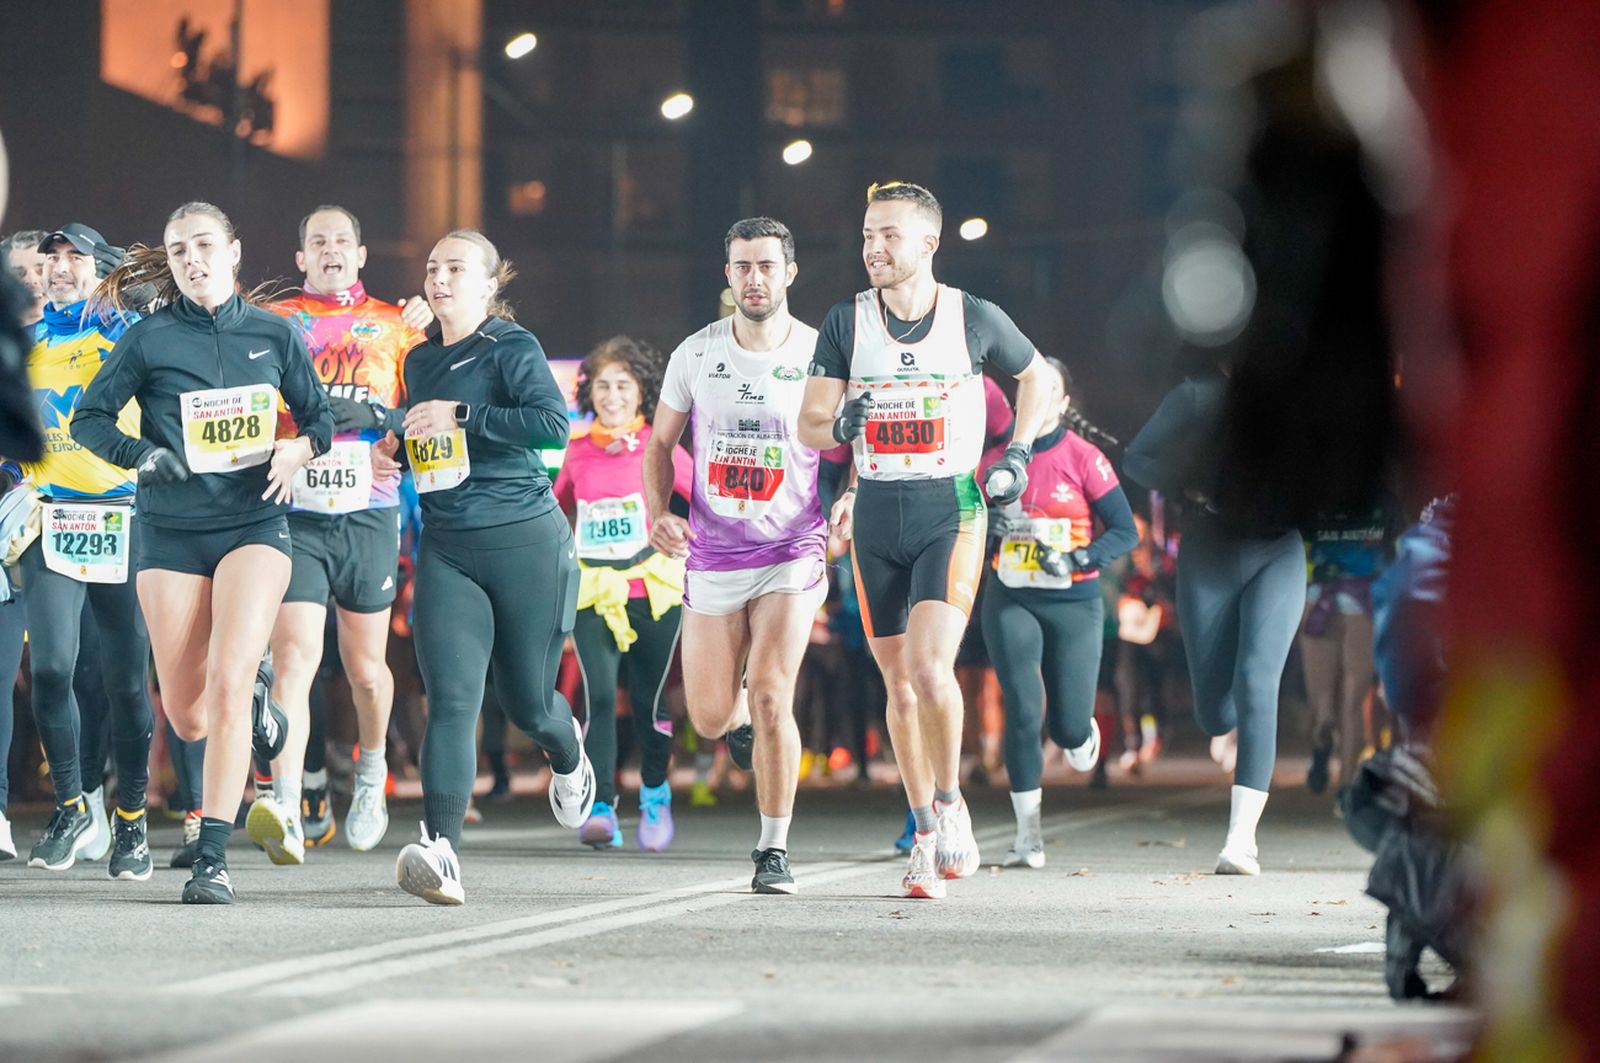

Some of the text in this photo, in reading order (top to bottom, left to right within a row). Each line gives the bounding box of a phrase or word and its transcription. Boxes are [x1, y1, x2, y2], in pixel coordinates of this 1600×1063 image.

[309, 345, 364, 384] OY
[203, 397, 241, 408] NOCHE DE
[876, 400, 915, 410] NOCHE DE
[193, 410, 212, 419] SAN
[869, 410, 885, 420] SAN
[202, 415, 260, 444] 4828
[717, 431, 747, 440] UTACIÓN
[876, 420, 934, 445] 4830
[52, 442, 83, 453] EJIDO
[412, 434, 453, 464] 4829
[306, 468, 356, 489] 6445
[725, 466, 764, 492] 840
[87, 513, 97, 521] DE
[52, 521, 68, 531] SAN
[588, 516, 632, 539] 1985
[52, 532, 117, 556] 12293
